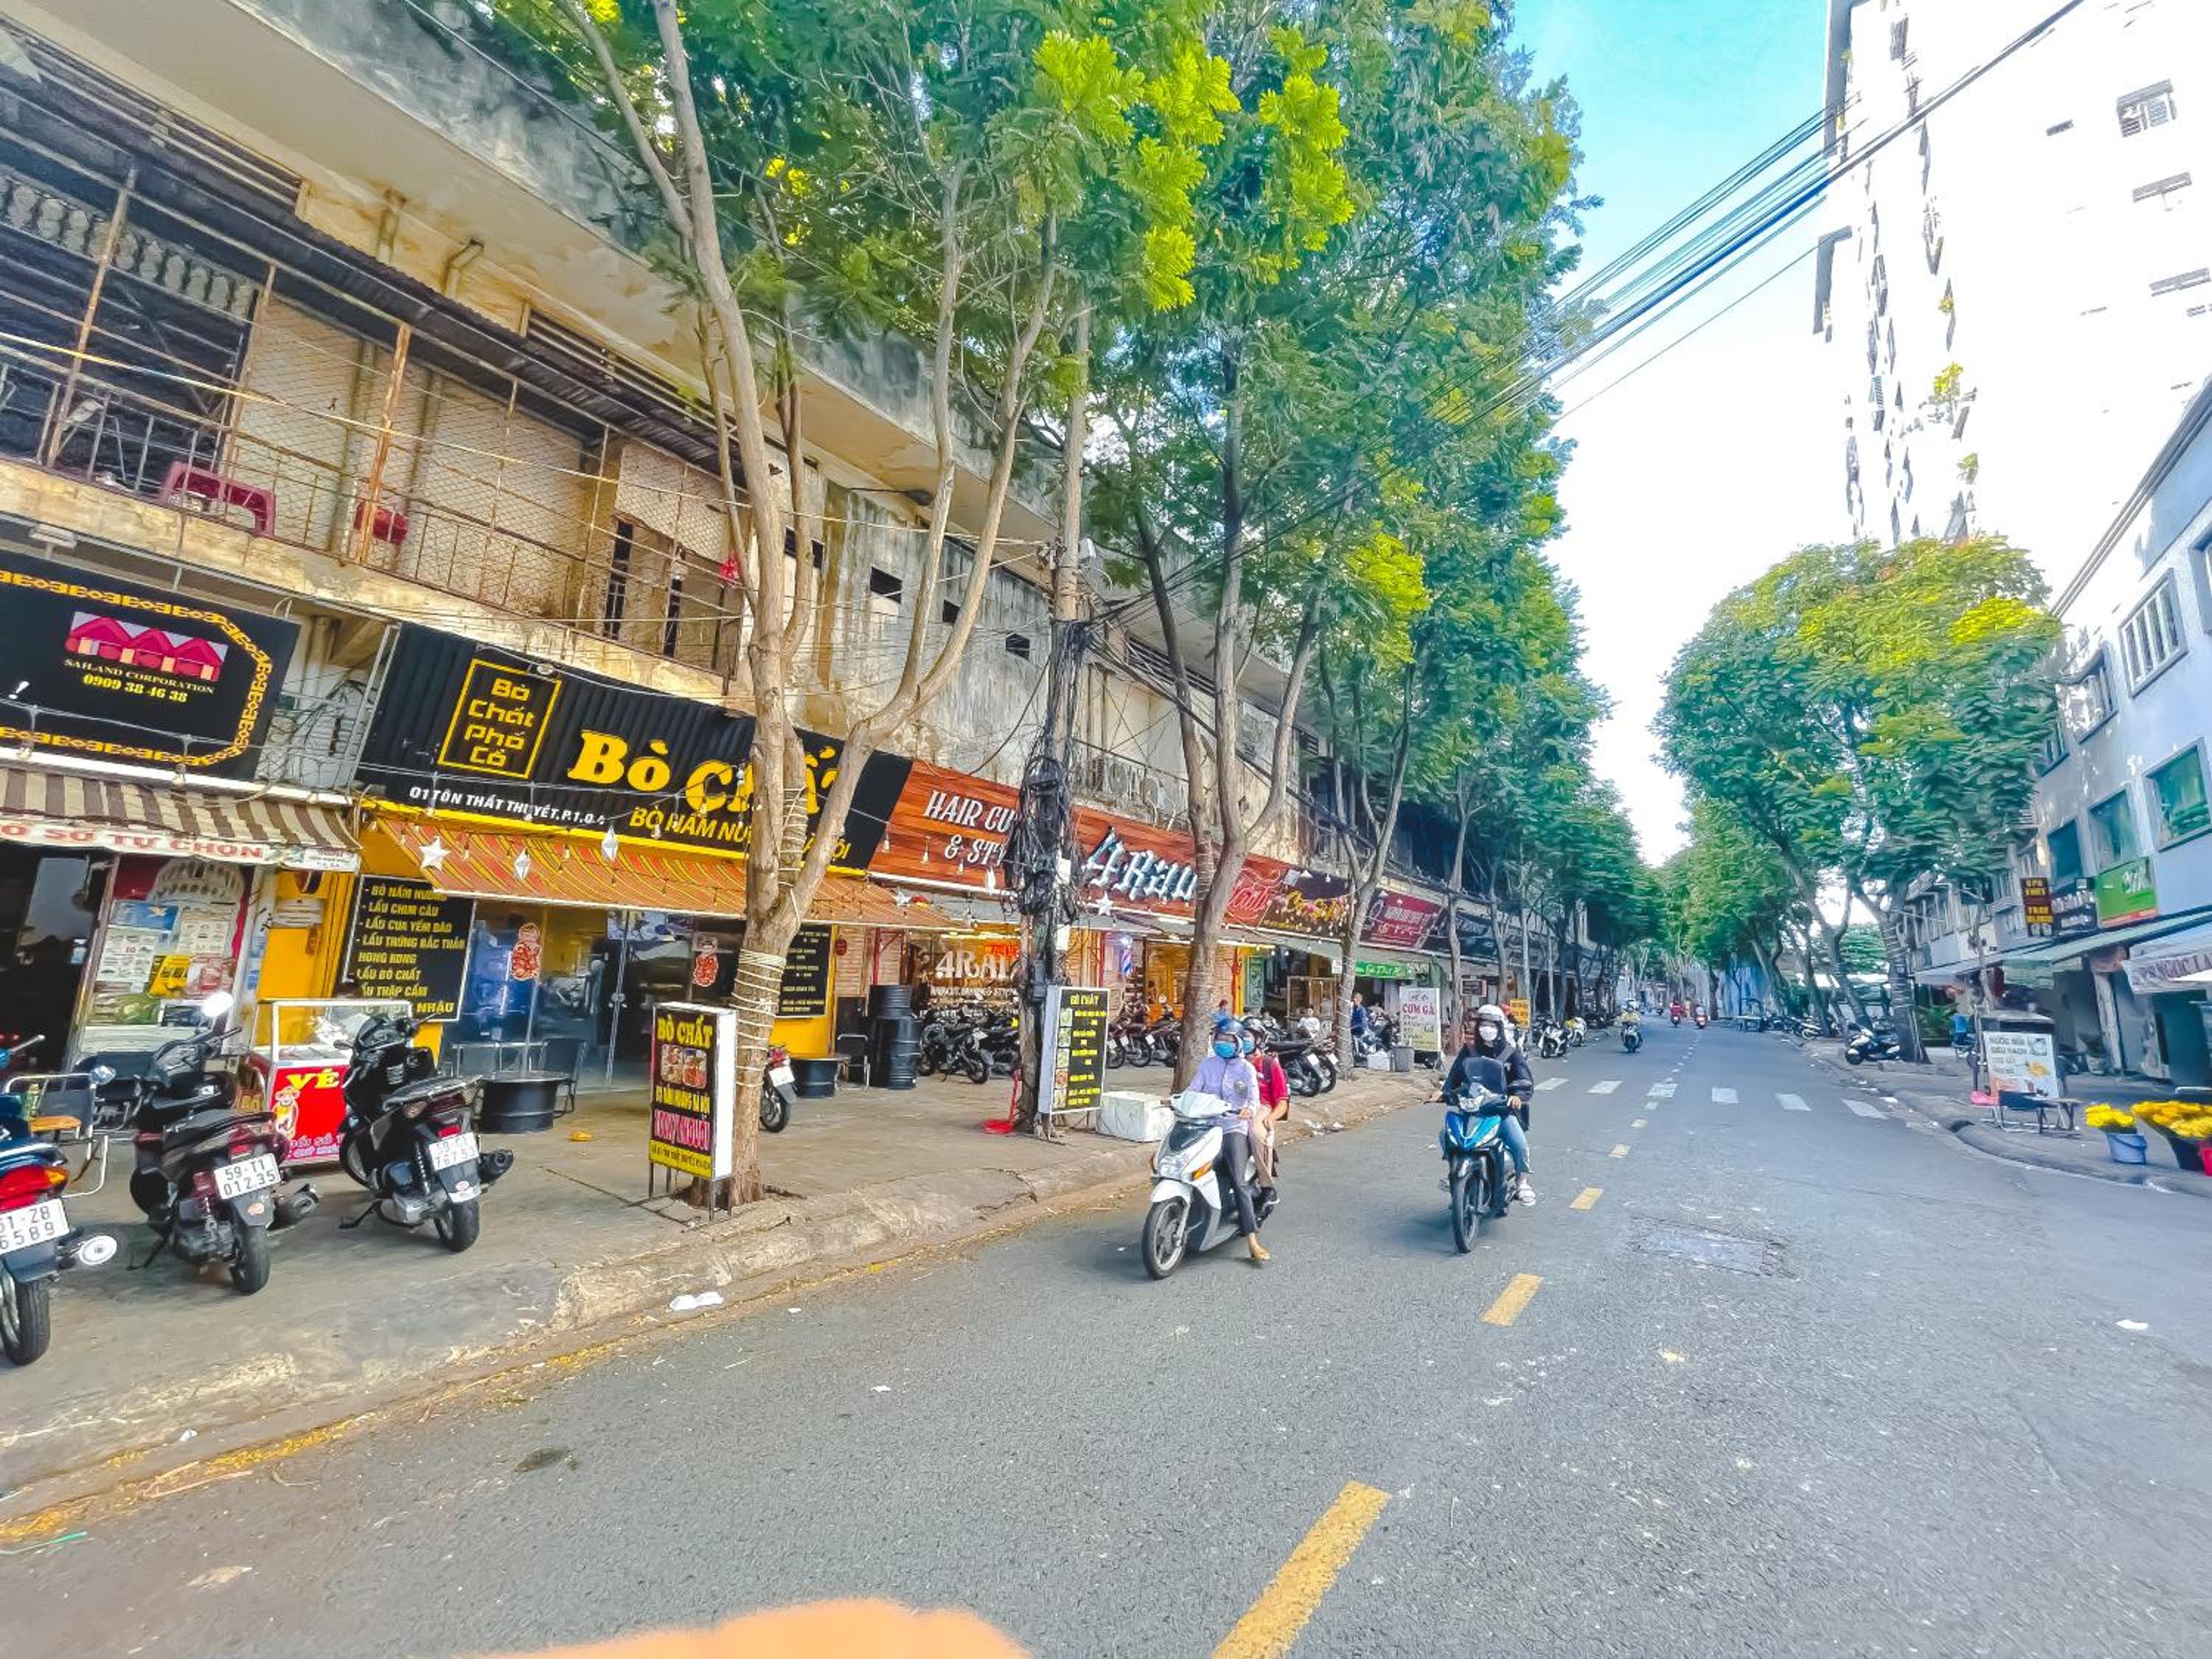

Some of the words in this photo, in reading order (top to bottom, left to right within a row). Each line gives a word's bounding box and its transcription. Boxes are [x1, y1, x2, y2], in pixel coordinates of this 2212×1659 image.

[83, 674, 121, 689] 0909
[124, 681, 144, 695] 38
[147, 686, 166, 699] 46
[169, 690, 189, 703] 38
[125, 671, 215, 694] CORPORATION
[491, 678, 530, 701] Bò
[468, 699, 534, 728] Chất
[567, 729, 670, 792] Bò
[409, 787, 428, 800] 01
[431, 789, 461, 805] TÔN
[465, 794, 507, 811] THẤT
[629, 805, 664, 830] BÒ
[924, 790, 983, 827] HAIR
[984, 806, 1018, 833] CU
[944, 834, 963, 860] &
[390, 904, 417, 915] CHIM
[387, 919, 408, 931] CUA
[416, 1000, 454, 1015] NHẬU
[657, 1013, 675, 1042] BÒ
[677, 1015, 713, 1048] CHẤT
[224, 1160, 266, 1181] 59-T1
